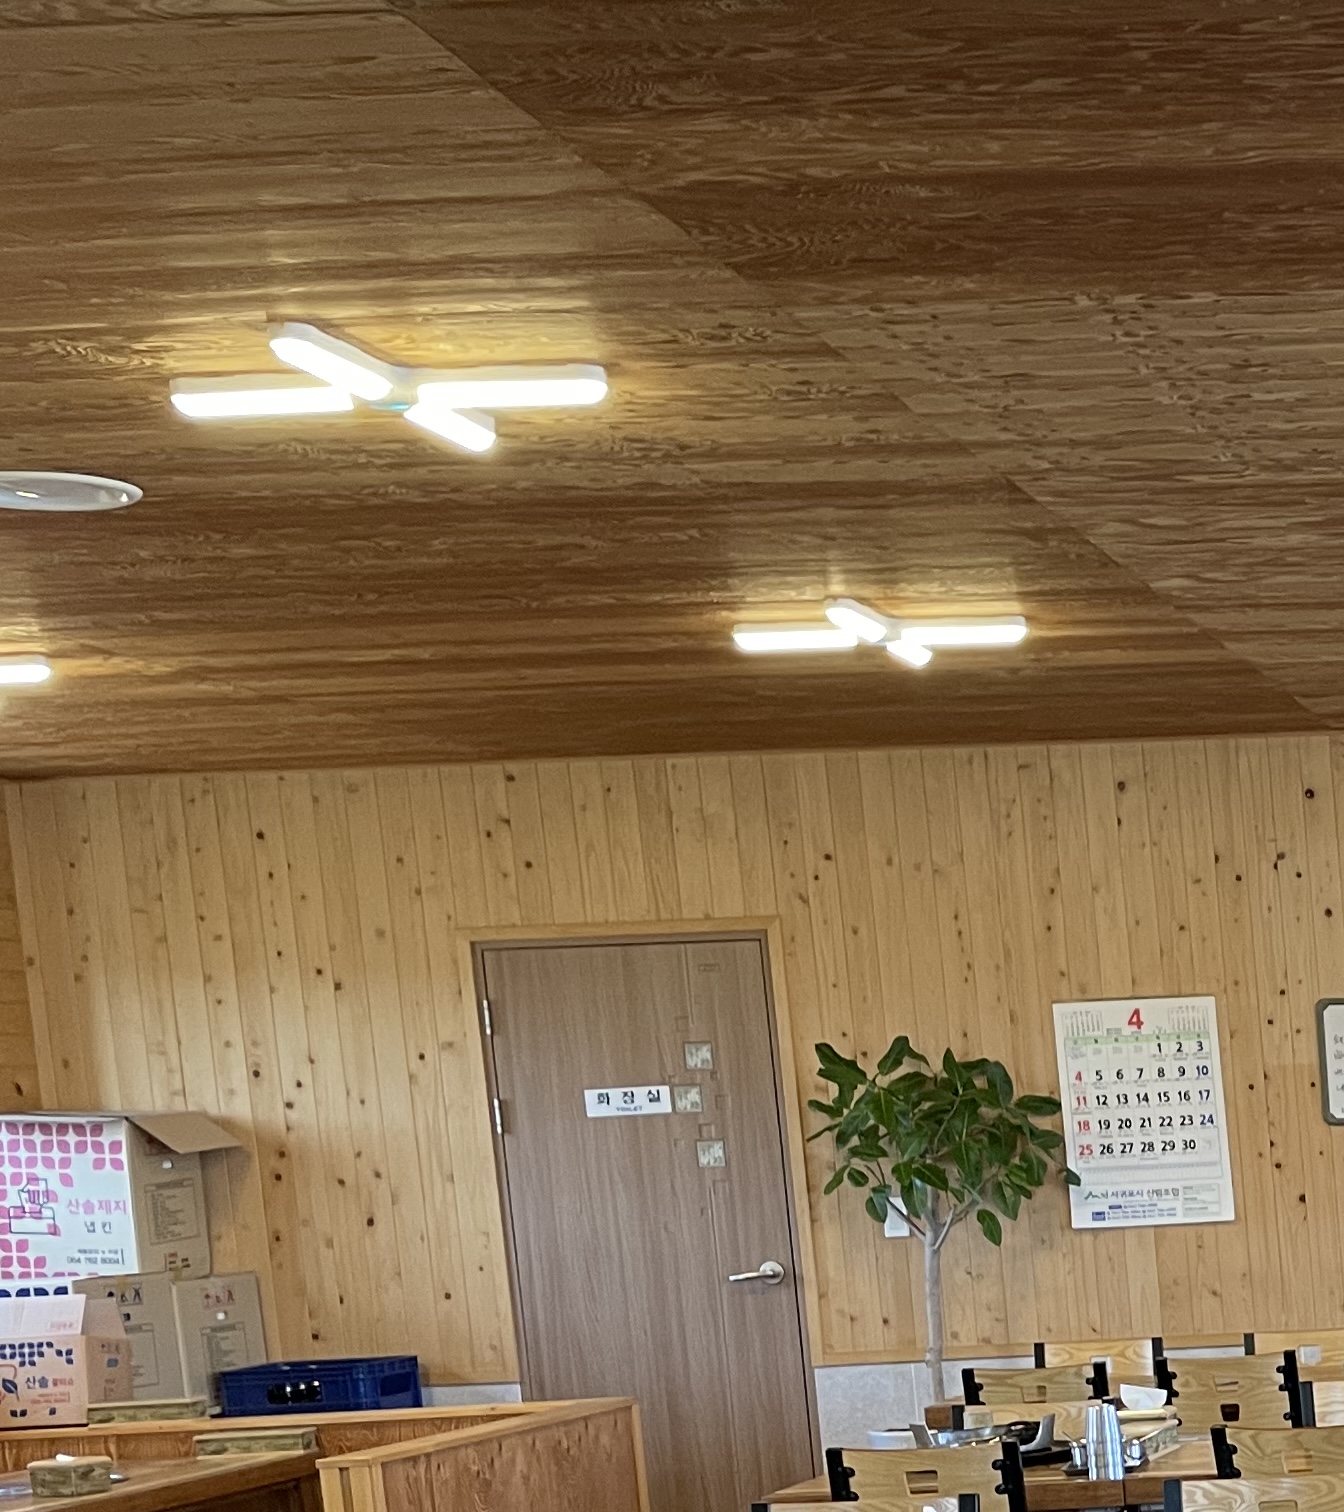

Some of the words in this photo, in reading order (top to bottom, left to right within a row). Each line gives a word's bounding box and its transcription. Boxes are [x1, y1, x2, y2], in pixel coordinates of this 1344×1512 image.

[1128, 1008, 1144, 1029] 4
[1157, 1043, 1162, 1053] 1
[1176, 1042, 1183, 1052] 2
[1196, 1041, 1203, 1051] 3
[1075, 1071, 1082, 1082] 4
[1096, 1070, 1103, 1081] 5
[1116, 1069, 1124, 1080] 6
[1136, 1068, 1144, 1079] 7
[1157, 1067, 1165, 1078] 8
[1178, 1066, 1186, 1077] 9
[1196, 1065, 1209, 1077] 10
[597, 1089, 661, 1105] 화장실
[1076, 1096, 1087, 1107] 11
[1096, 1095, 1108, 1106] 12
[1116, 1094, 1128, 1105] 13
[1136, 1092, 1149, 1104] 14
[1157, 1091, 1170, 1102] 15
[1178, 1090, 1191, 1101] 16
[1198, 1090, 1210, 1101] 17
[1077, 1120, 1090, 1132] 18
[1098, 1119, 1110, 1130] 19
[1118, 1118, 1132, 1129] 20
[1139, 1117, 1152, 1128] 21
[1159, 1116, 1173, 1127] 22
[1179, 1115, 1193, 1126] 23
[1200, 1114, 1214, 1125] 24
[1078, 1144, 1093, 1156] 25
[1100, 1144, 1114, 1155] 26
[1120, 1143, 1134, 1154] 27
[1140, 1142, 1155, 1152] 28
[1161, 1140, 1175, 1151] 29
[1182, 1139, 1196, 1150] 30
[67, 1198, 127, 1215] 산솔제지
[25, 1376, 48, 1389] 산솔
